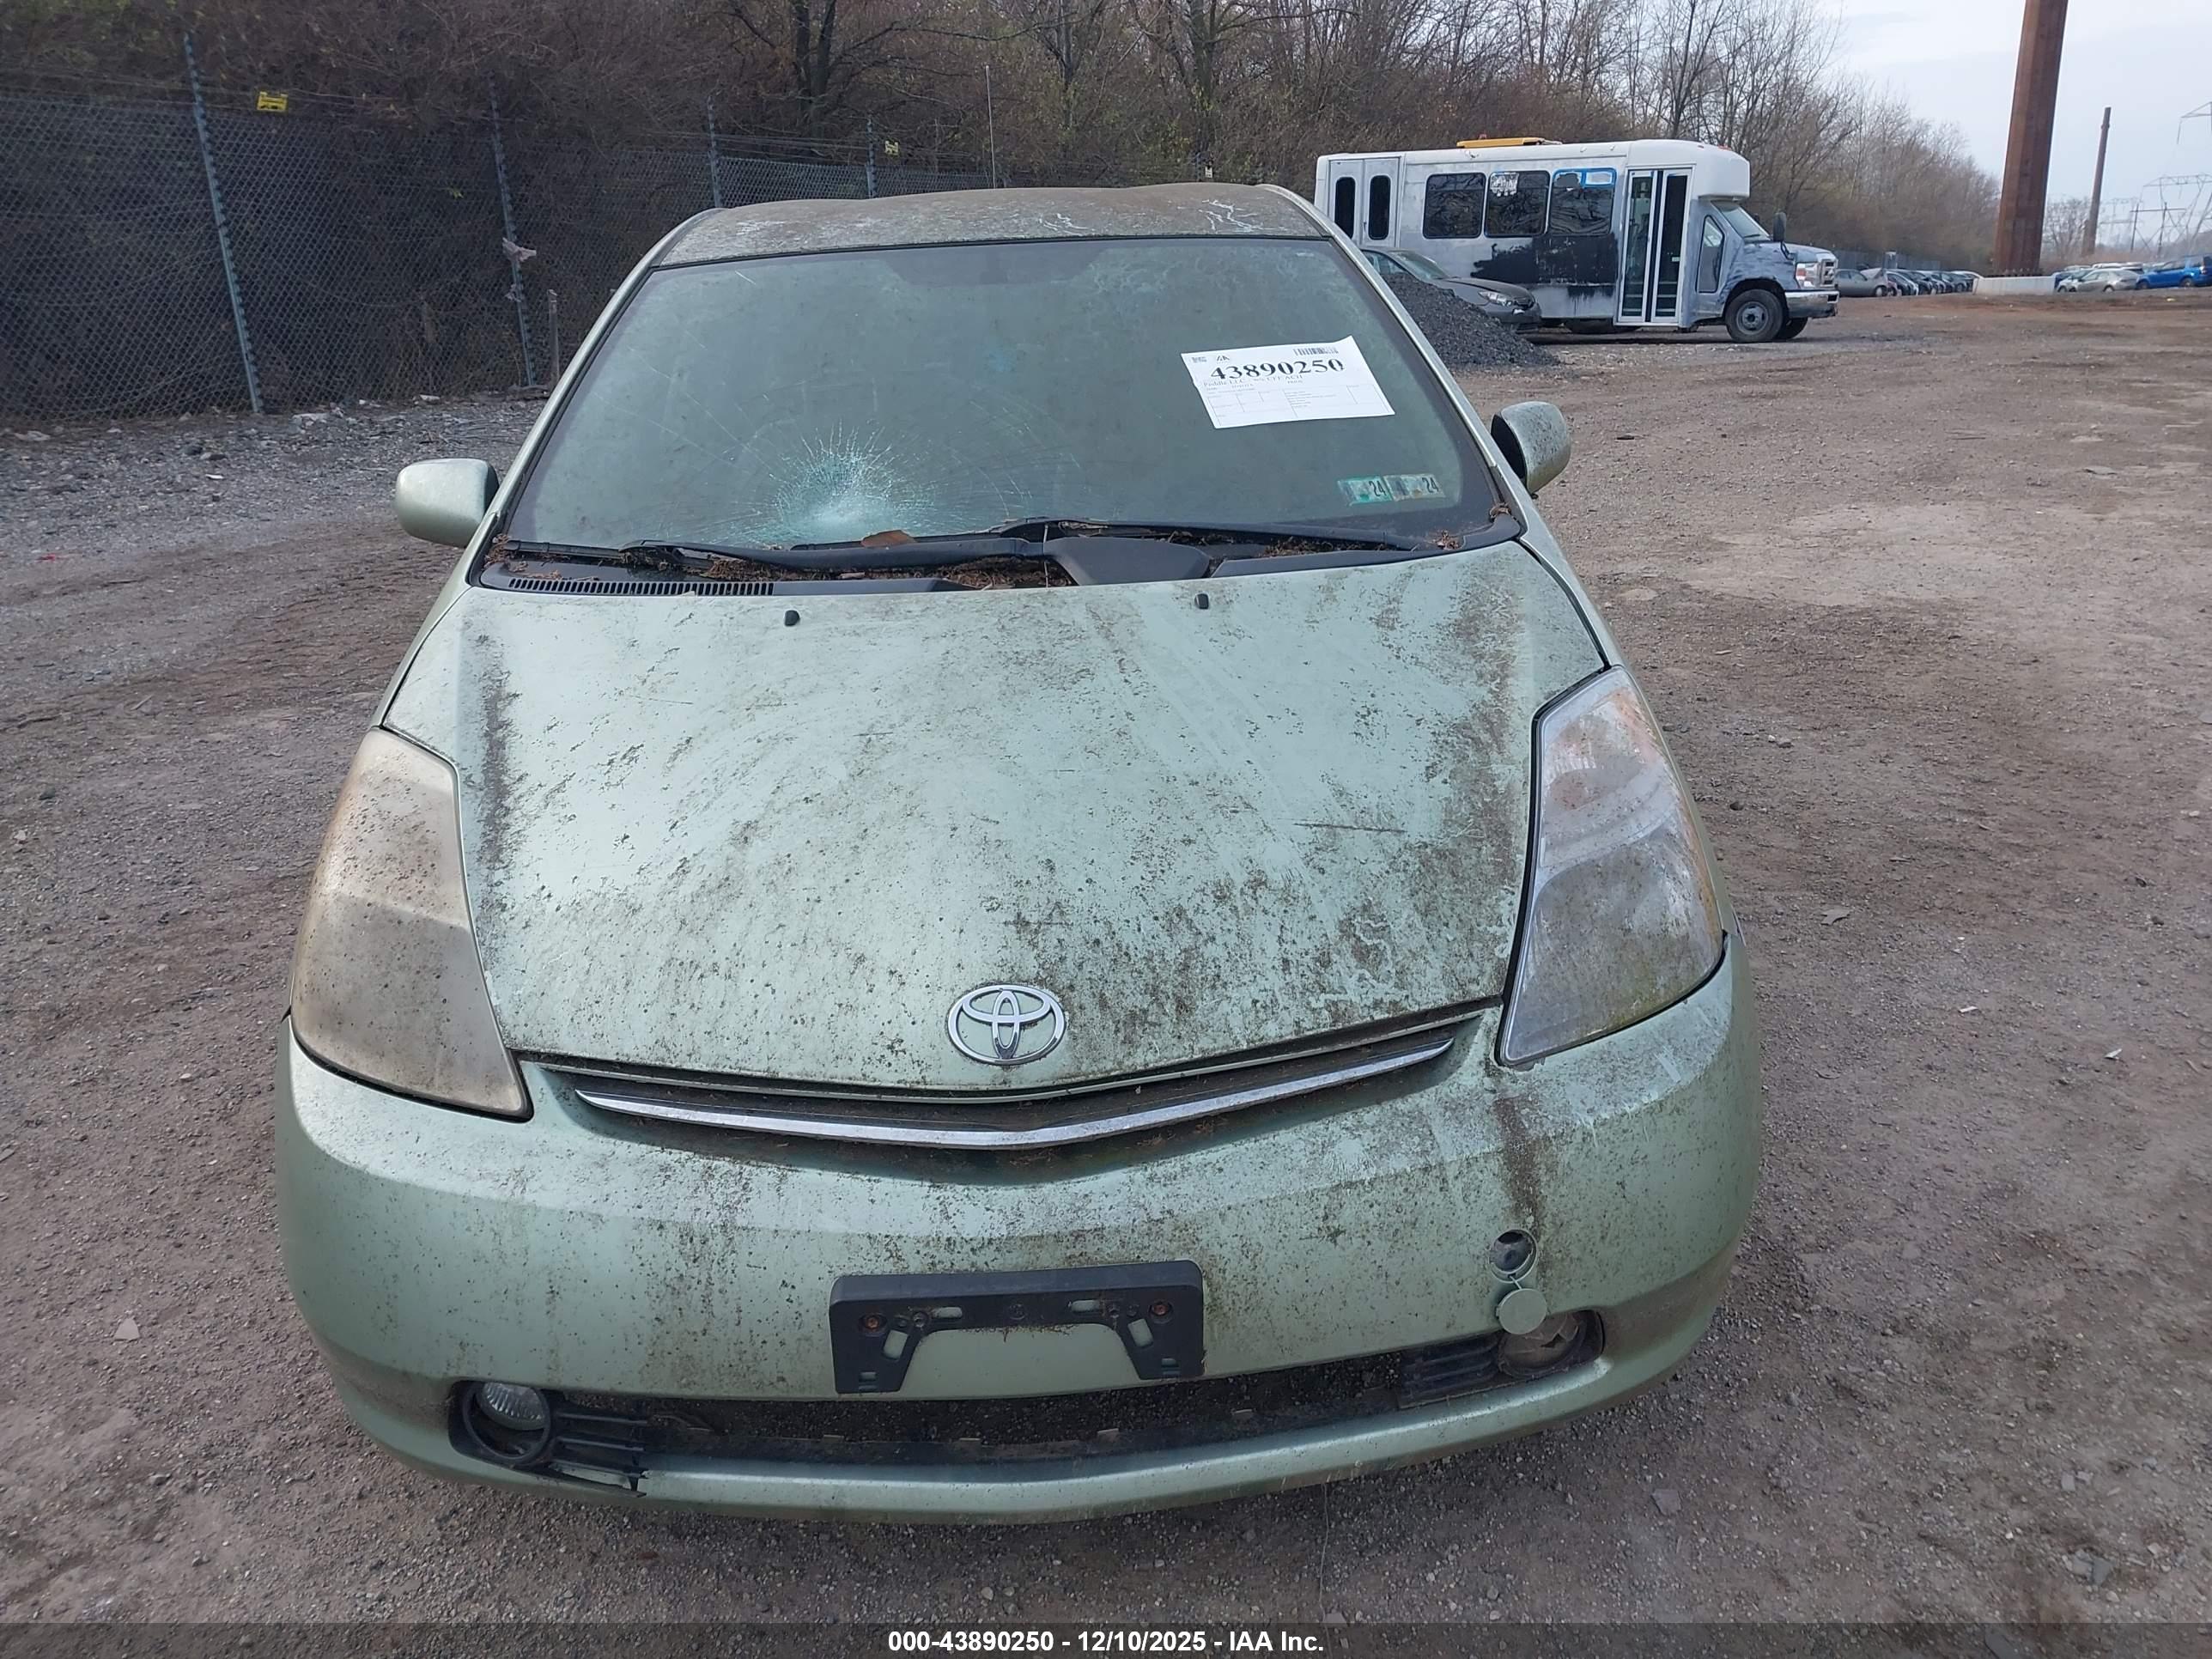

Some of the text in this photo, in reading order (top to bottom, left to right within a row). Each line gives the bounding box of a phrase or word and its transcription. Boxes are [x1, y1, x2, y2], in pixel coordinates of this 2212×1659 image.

[1211, 358, 1345, 380] 43890250
[1368, 480, 1388, 497] 24
[1421, 477, 1440, 494] 24
